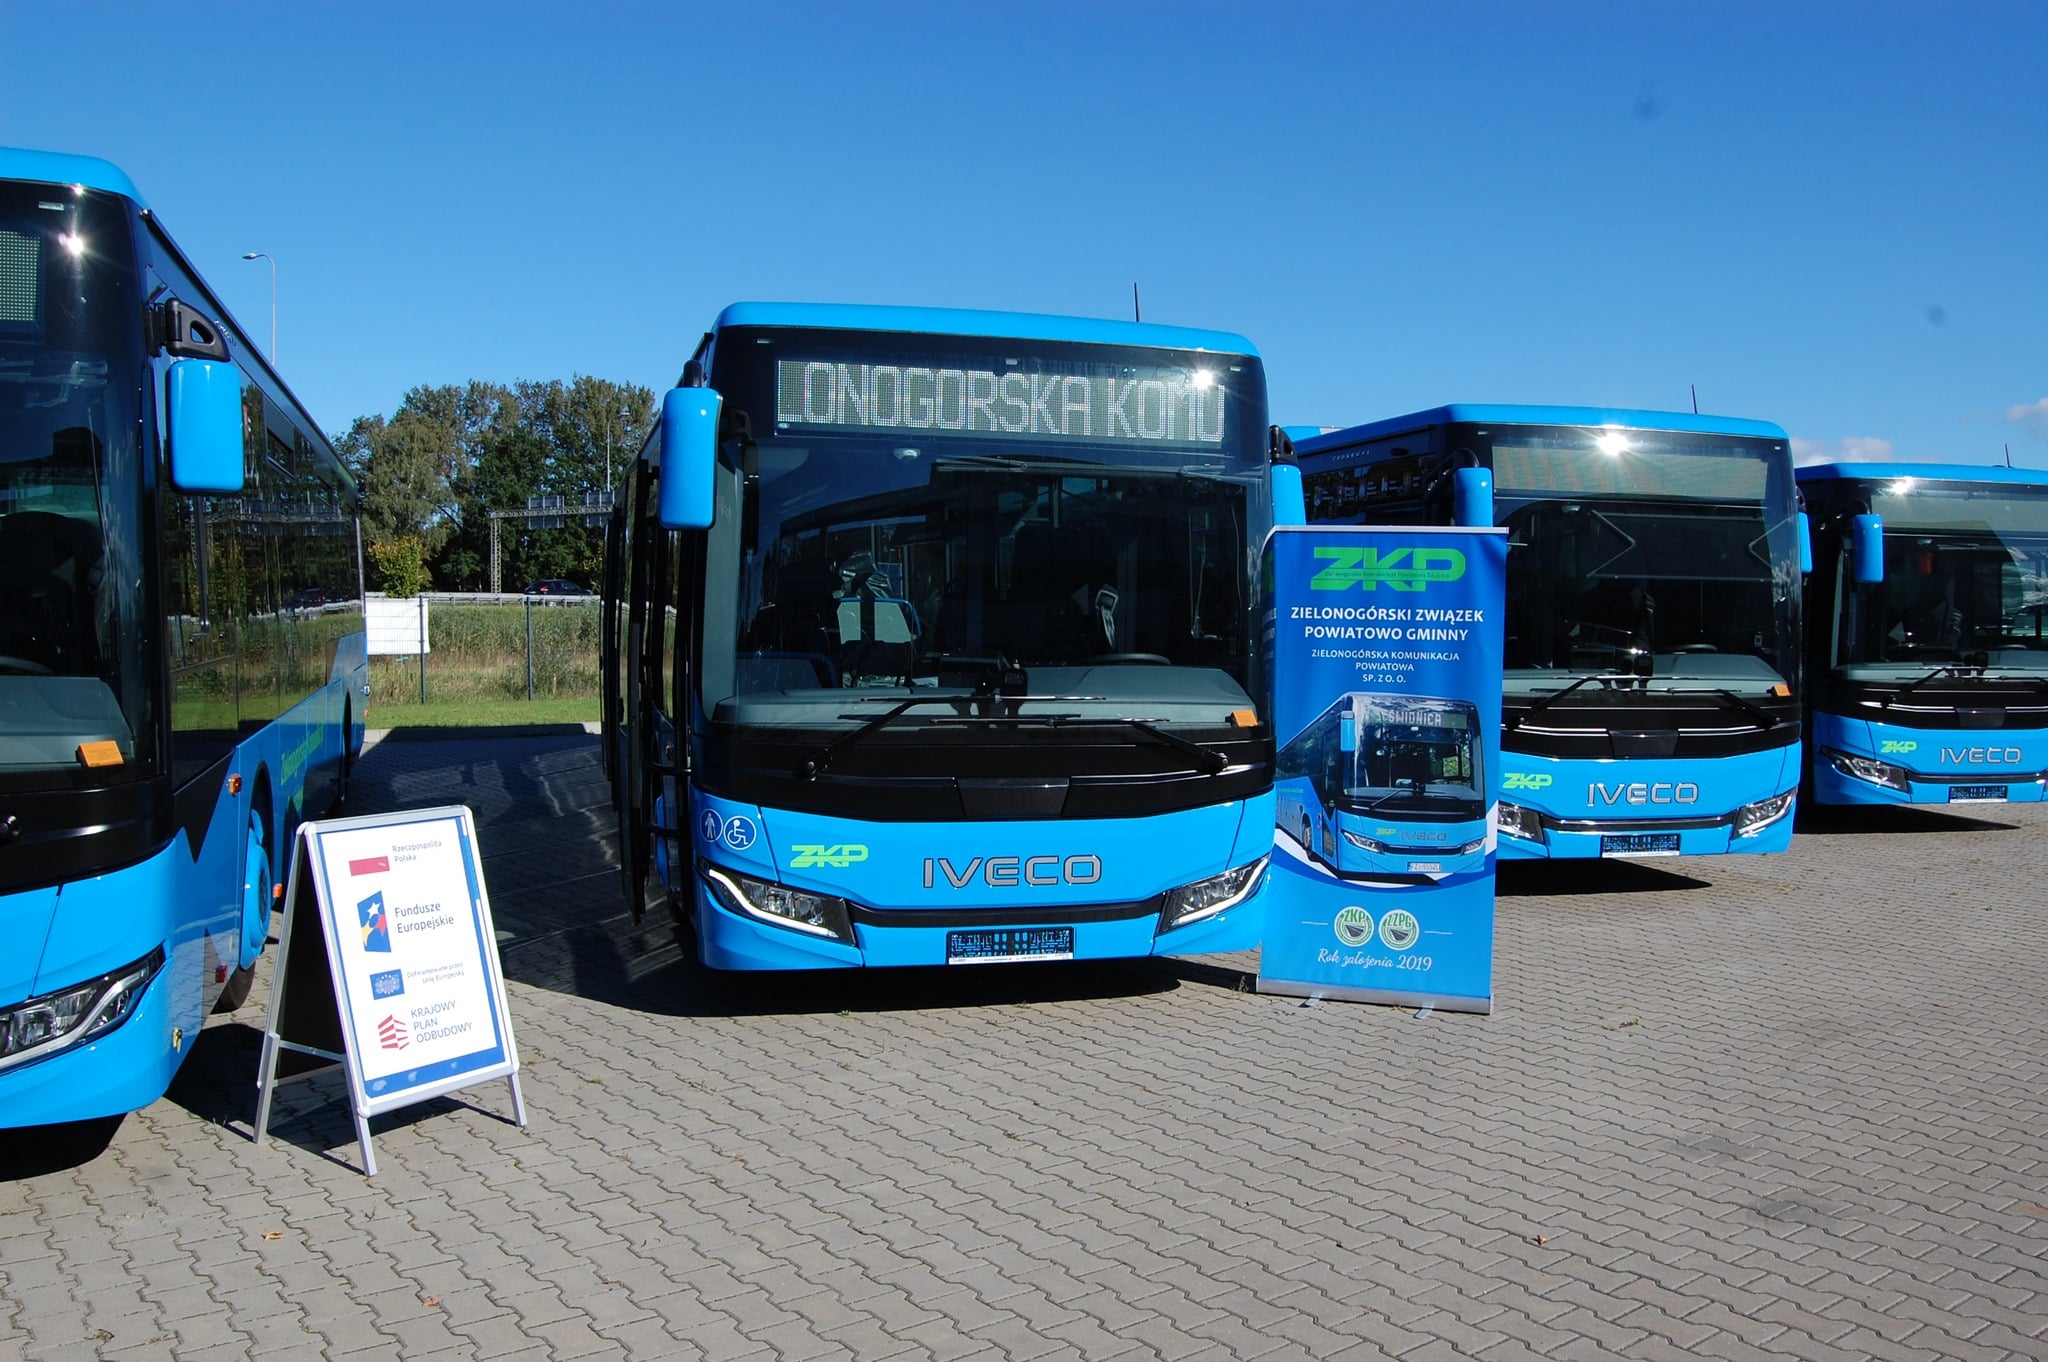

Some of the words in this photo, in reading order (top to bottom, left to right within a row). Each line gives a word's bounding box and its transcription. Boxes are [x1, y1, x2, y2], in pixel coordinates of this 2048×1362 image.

[1310, 546, 1466, 592] ZKP
[1290, 605, 1411, 621] ZIELONOGÓRSKI
[1415, 609, 1484, 625] ZWIĄZEK
[1304, 626, 1403, 640] POWIATOWO
[1406, 628, 1469, 641] GMINNY
[1311, 649, 1389, 659] ZIELONOGÓRSKA
[1391, 651, 1460, 661] KOMUNIKACJA
[1355, 662, 1414, 671] POWIATOWA
[1362, 673, 1377, 682] SP.
[1378, 674, 1384, 682] Z
[1388, 708, 1442, 726] ŚWIDNICA
[1880, 740, 1918, 754] ZKP
[1940, 747, 2022, 764] IVECO
[1502, 772, 1553, 790] ZKP
[1587, 782, 1699, 807] IVECO
[1400, 831, 1447, 841] IVECO
[394, 854, 417, 863] Polska
[790, 844, 869, 867] ZKP
[922, 854, 1102, 889] IVECO
[394, 902, 441, 918] Fundusze
[1344, 908, 1366, 923] ZKP
[397, 914, 454, 934] Europejskie
[1318, 948, 1340, 963] Rok
[1396, 954, 1433, 972] 2019
[411, 1000, 456, 1019] KRAJOWY
[413, 1017, 438, 1031] PLAN
[416, 1021, 472, 1043] ODBUDOWY
